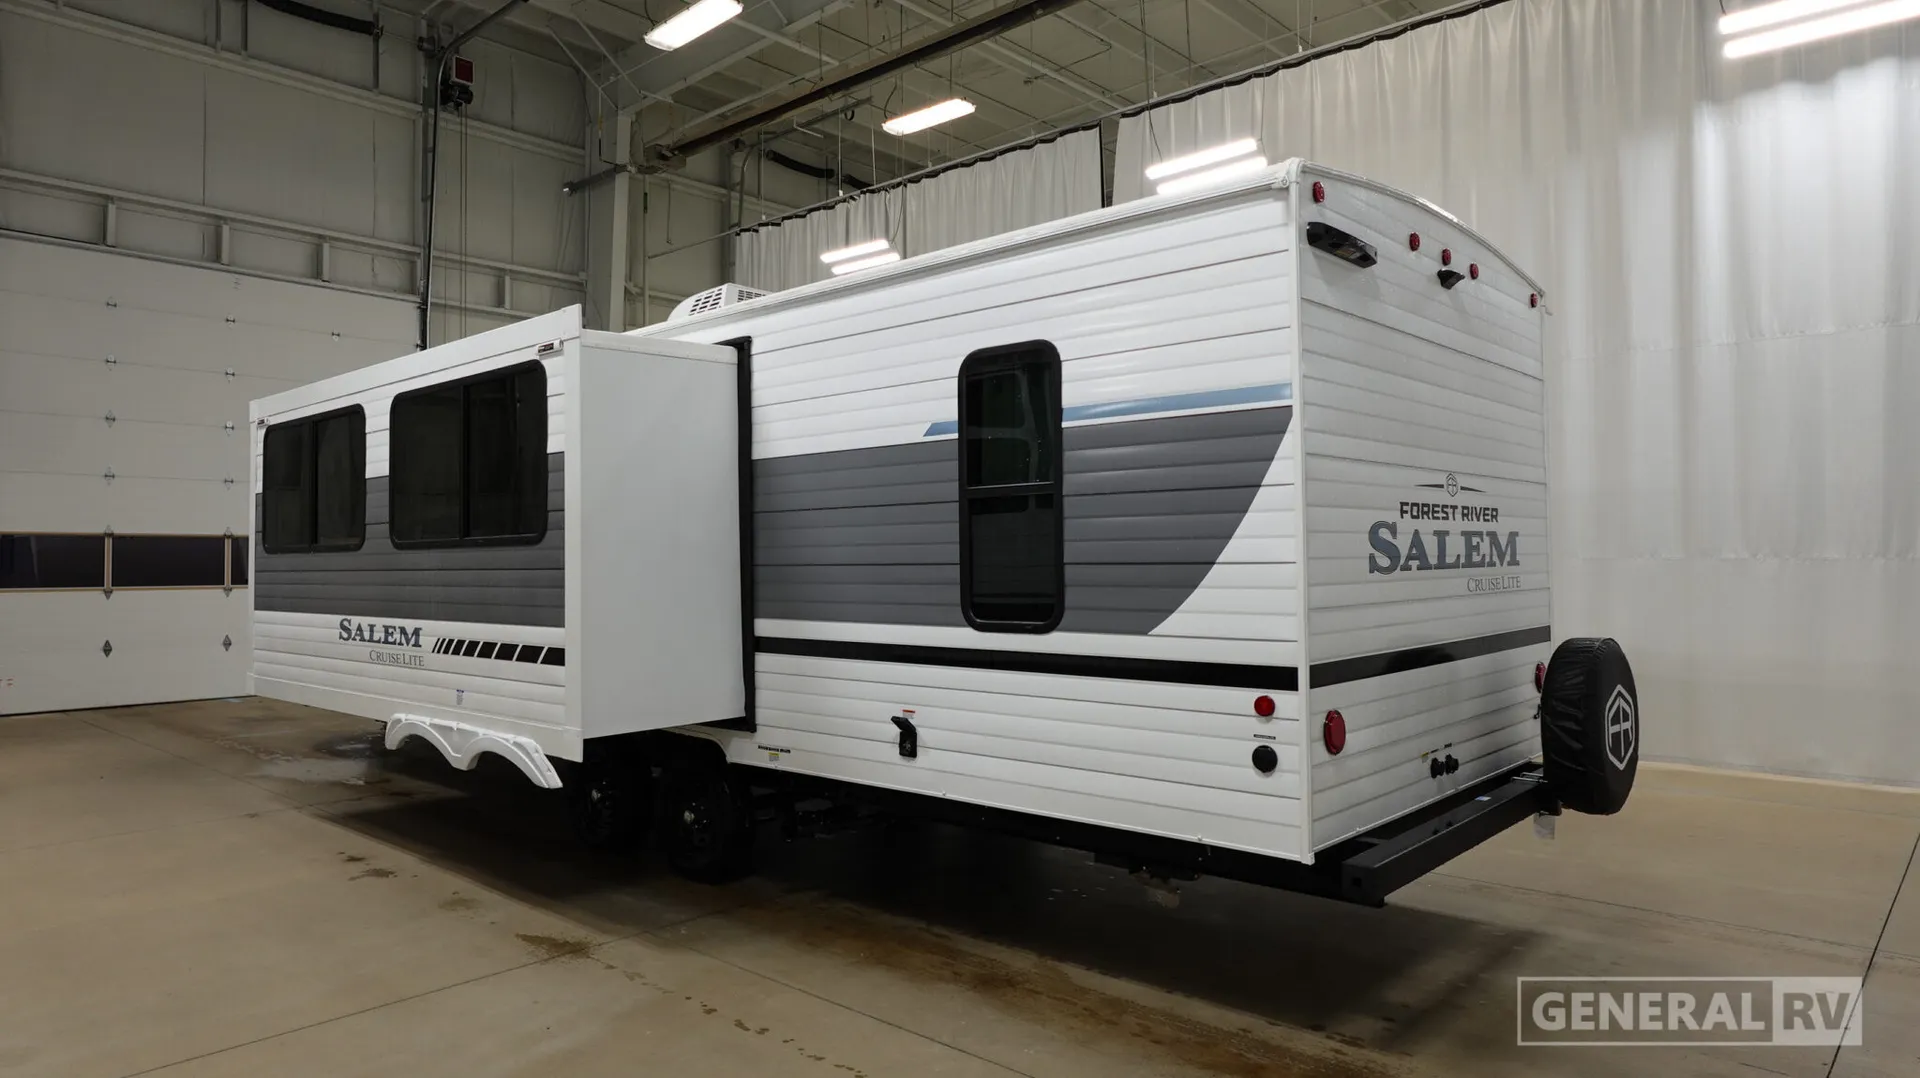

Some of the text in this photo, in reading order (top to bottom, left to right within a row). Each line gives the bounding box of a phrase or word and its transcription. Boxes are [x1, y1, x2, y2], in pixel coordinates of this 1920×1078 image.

[1399, 501, 1499, 523] FOREST RIVER
[1368, 520, 1520, 575] SALEM
[338, 617, 423, 648] SALEM
